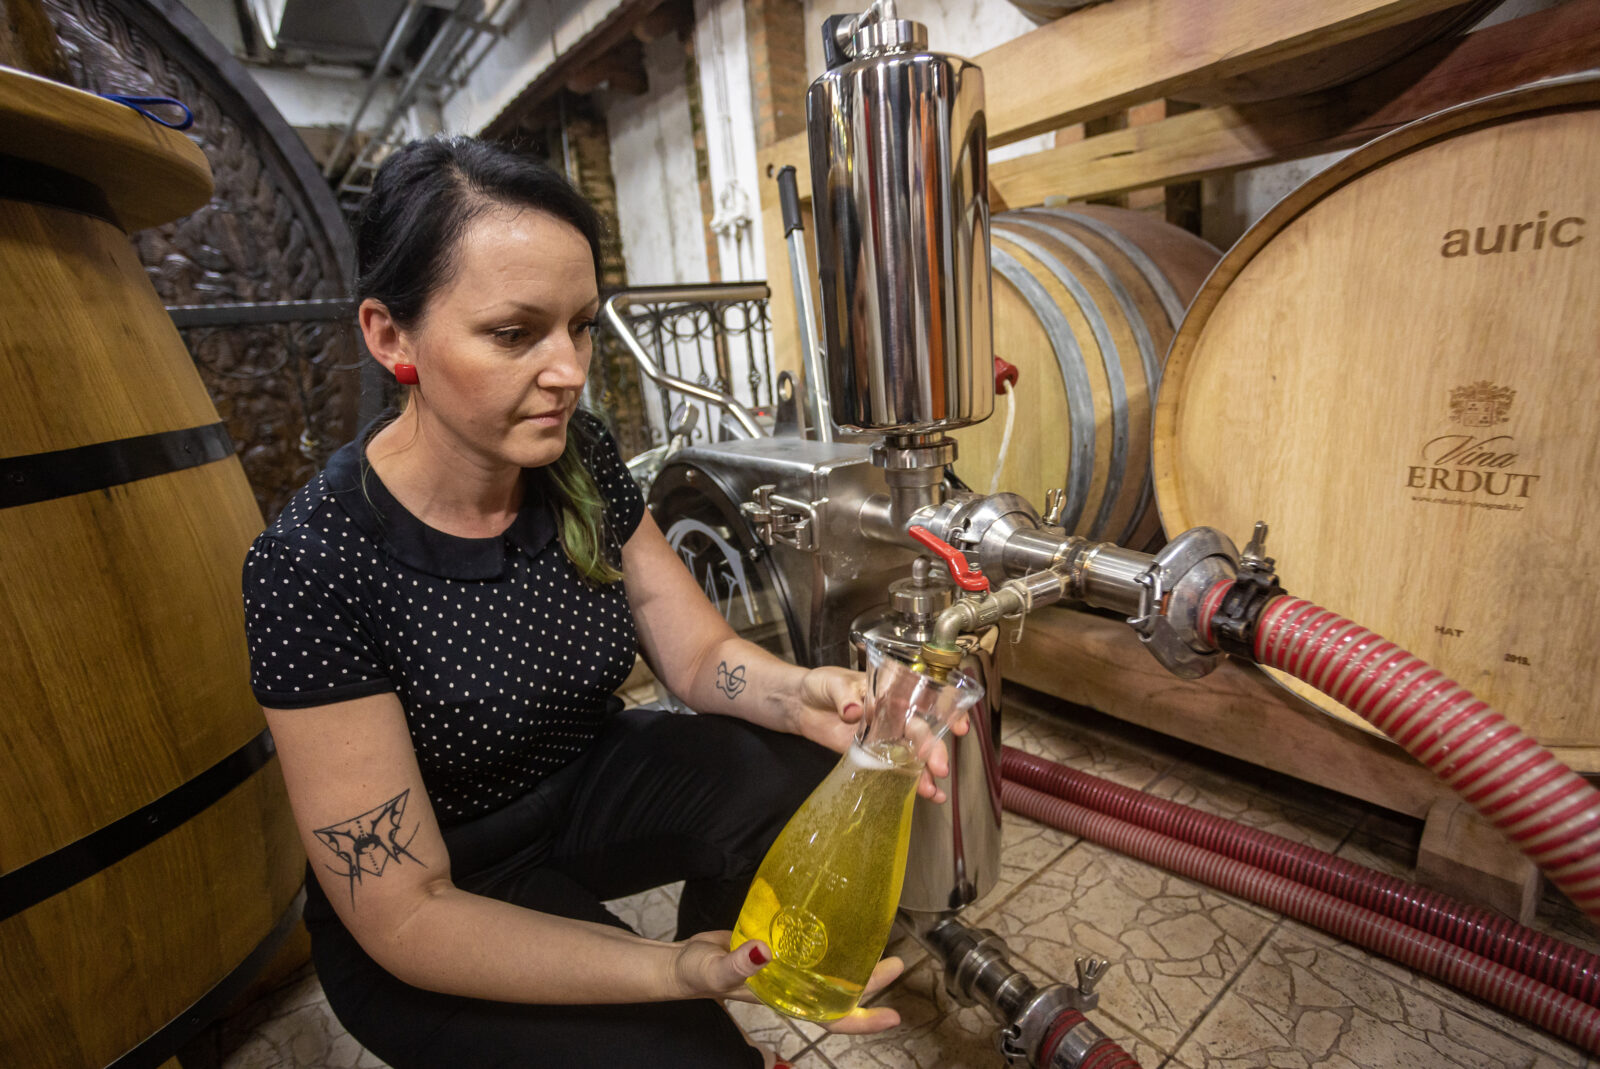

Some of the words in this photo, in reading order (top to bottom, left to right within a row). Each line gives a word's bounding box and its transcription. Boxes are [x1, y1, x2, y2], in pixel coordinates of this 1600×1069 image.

[1441, 210, 1587, 257] auric
[1423, 434, 1519, 468] Vina
[1406, 466, 1540, 498] ERDUT
